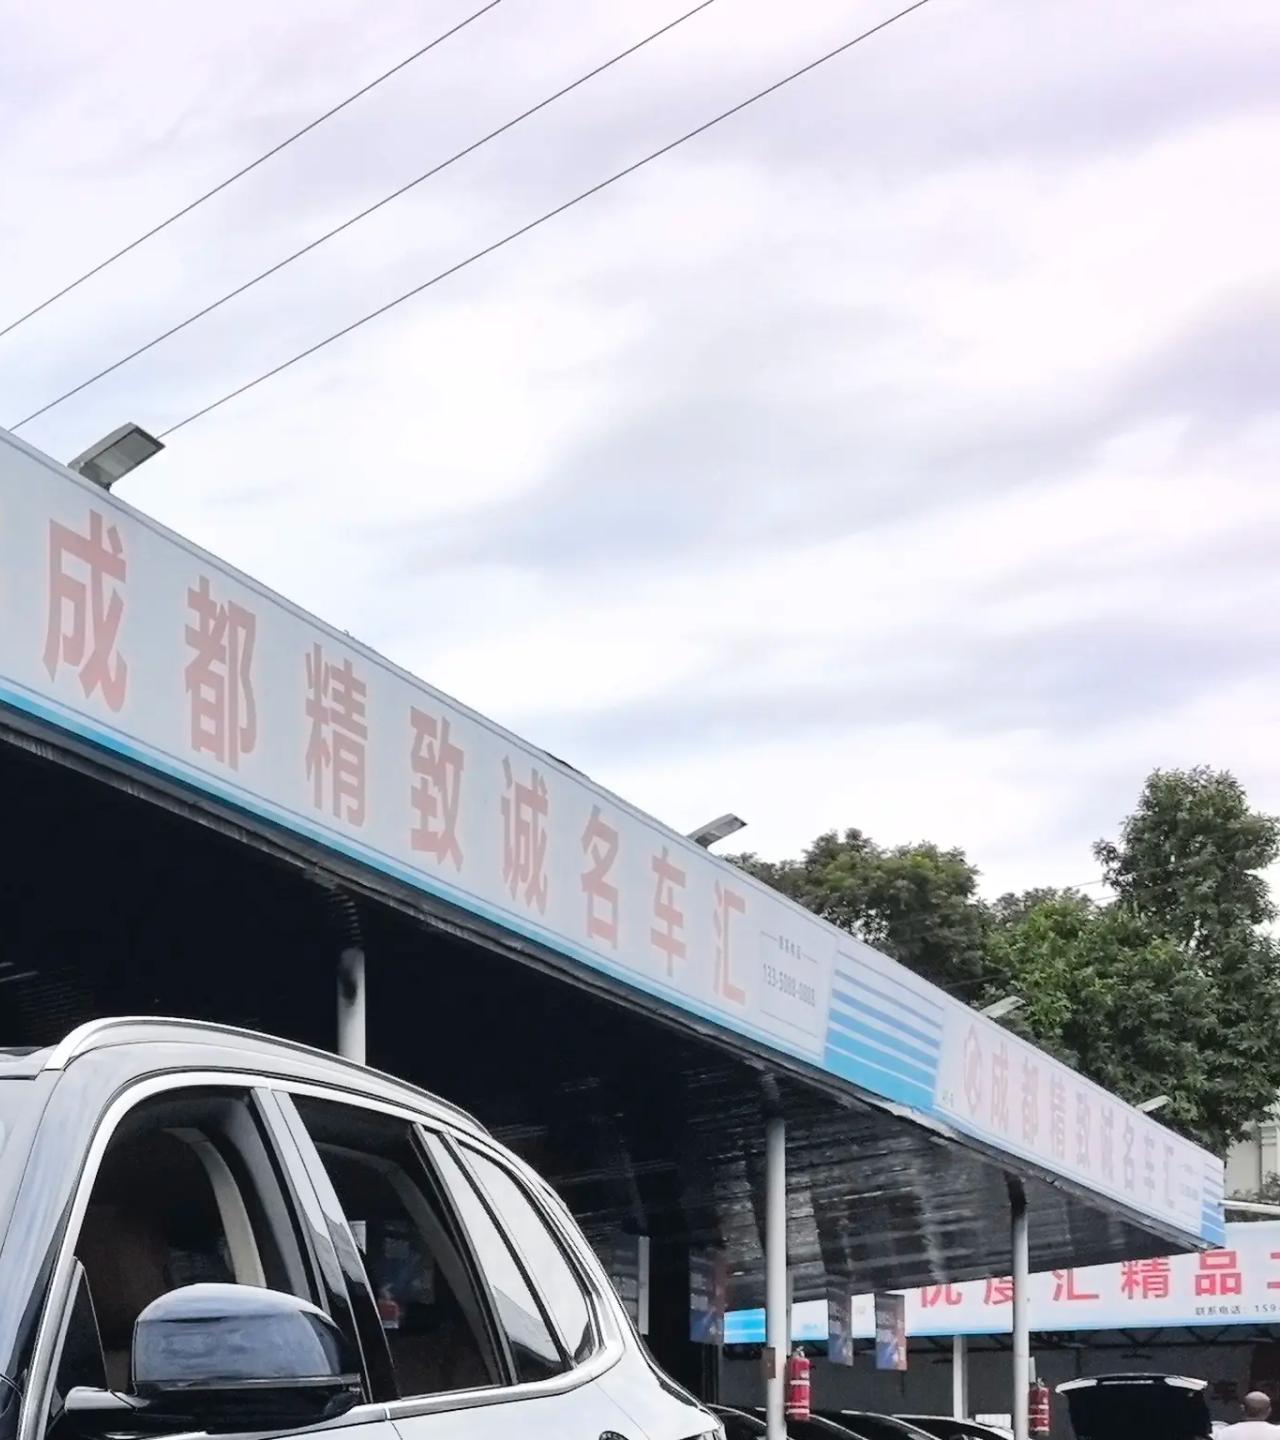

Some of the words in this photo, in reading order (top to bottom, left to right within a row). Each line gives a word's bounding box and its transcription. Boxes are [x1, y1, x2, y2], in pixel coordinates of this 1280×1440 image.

[42, 508, 746, 1005] 成都精致诚名车汇
